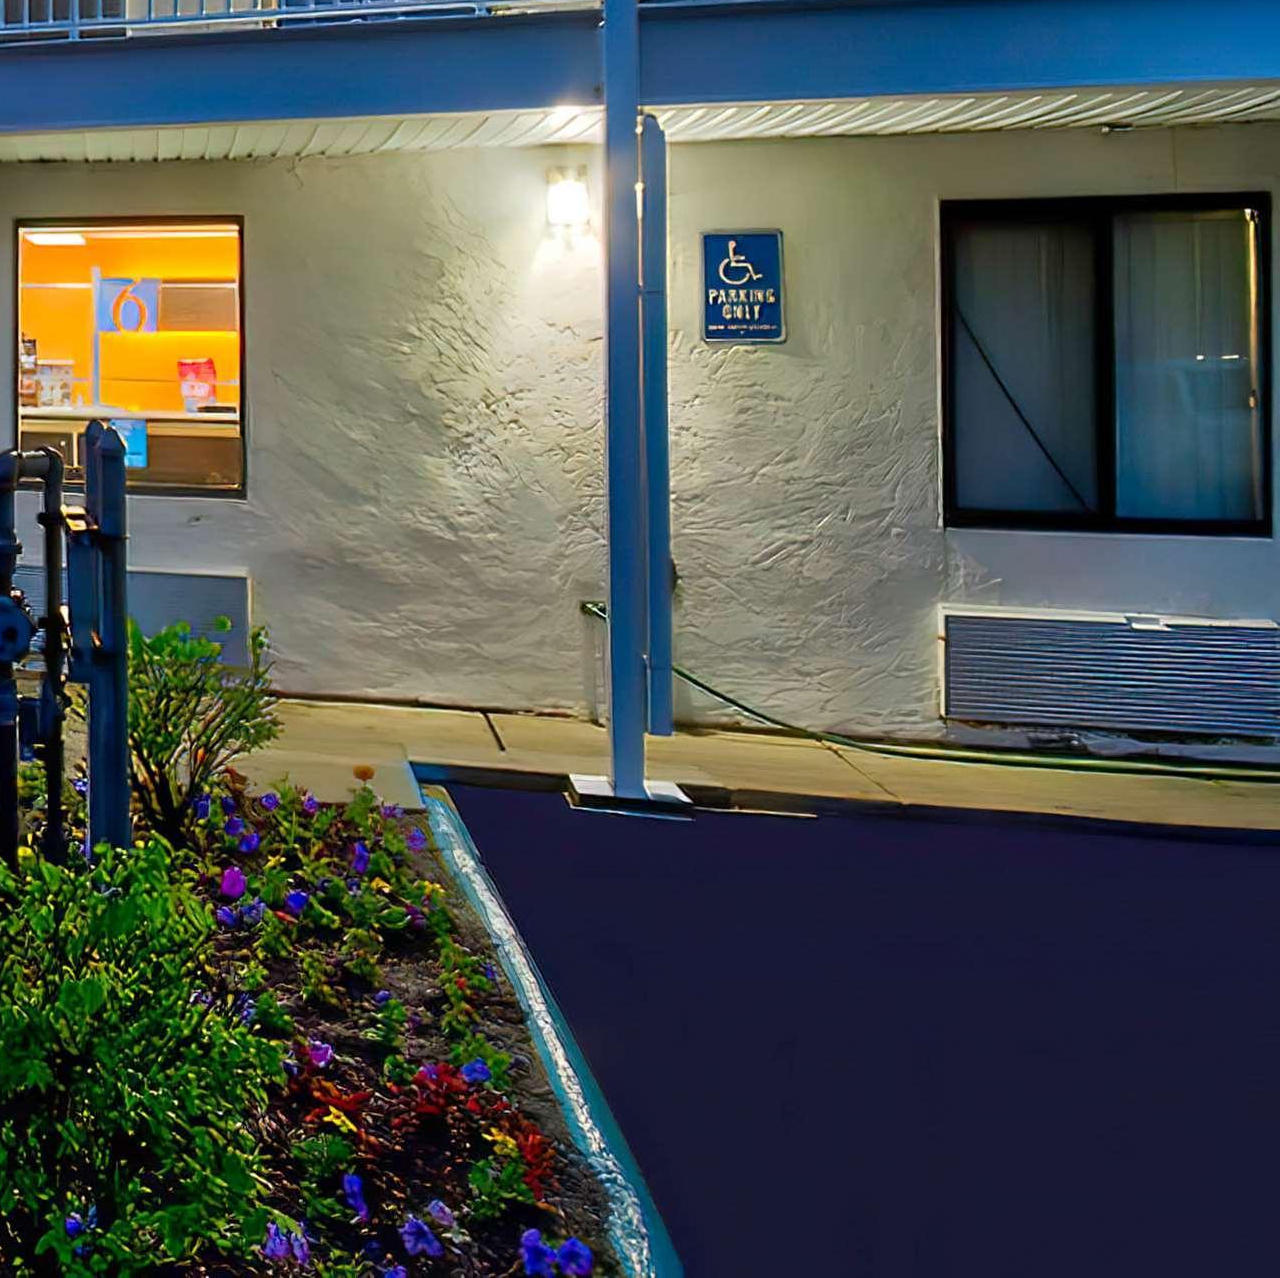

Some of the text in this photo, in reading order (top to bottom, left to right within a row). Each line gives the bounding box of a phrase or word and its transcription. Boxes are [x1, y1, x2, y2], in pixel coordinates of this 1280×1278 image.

[112, 275, 148, 333] 6
[708, 289, 776, 305] PARKING
[722, 304, 761, 321] ONLY
